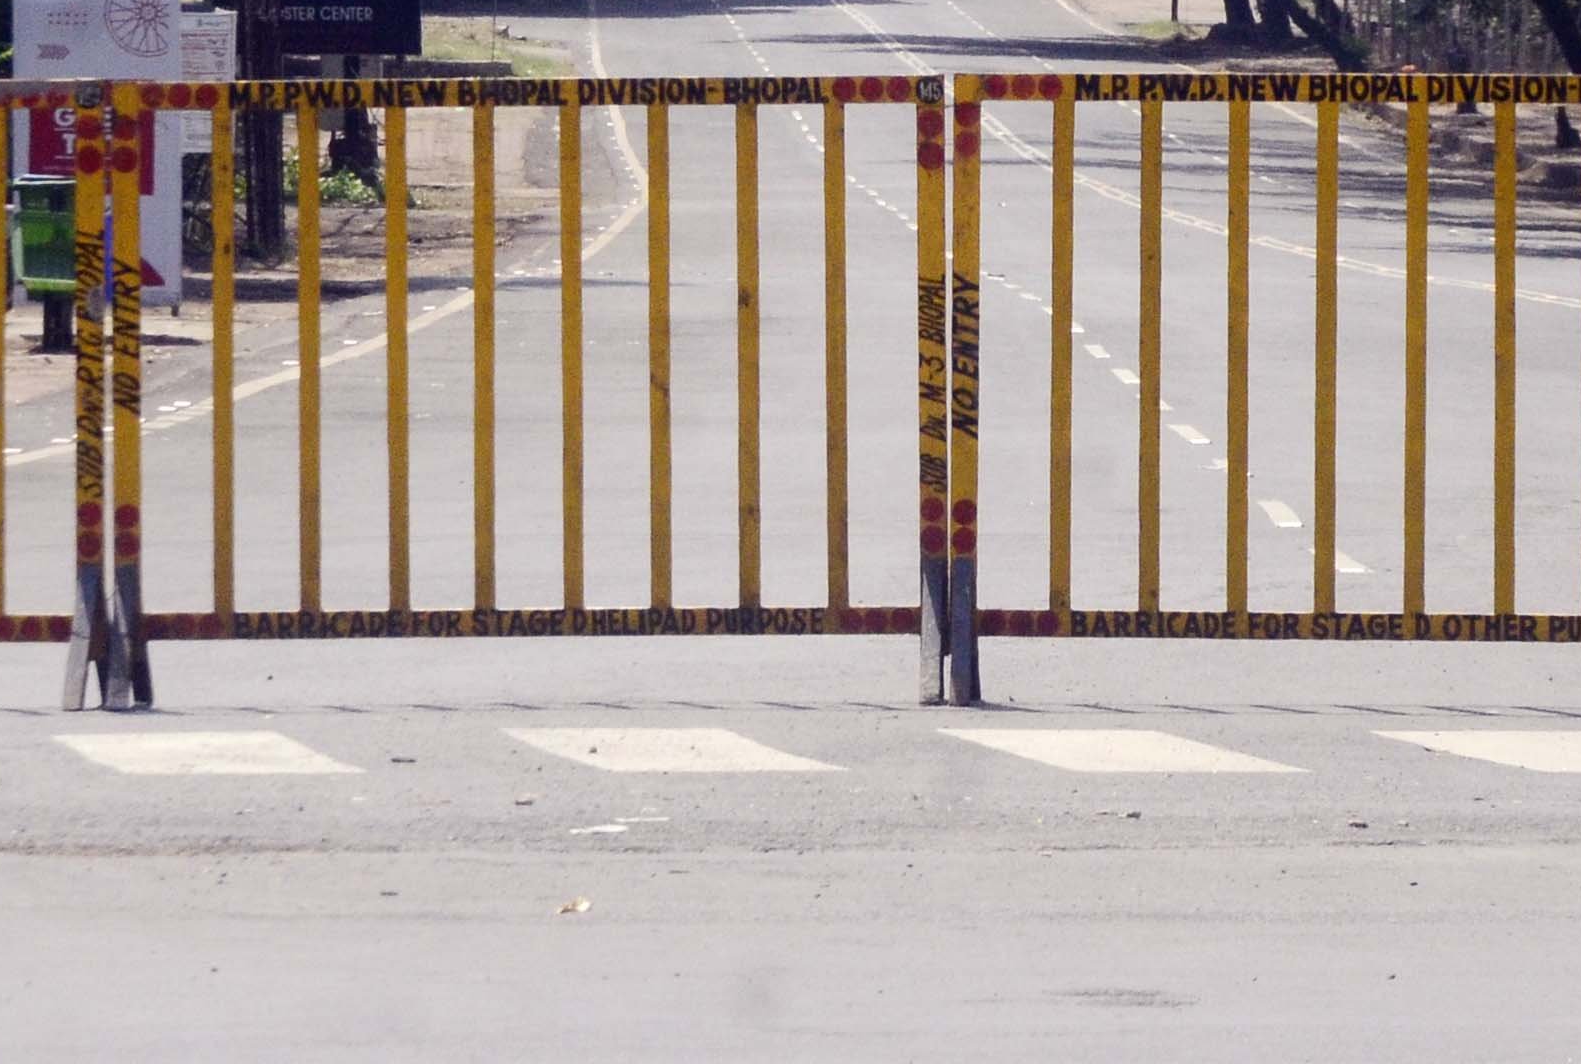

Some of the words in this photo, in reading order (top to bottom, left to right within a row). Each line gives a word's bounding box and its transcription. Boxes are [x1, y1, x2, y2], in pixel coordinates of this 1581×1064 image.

[320, 6, 374, 21] CENTER
[373, 81, 450, 108] NEW
[458, 80, 567, 106] BHOPAL
[1228, 76, 1301, 102] NEW
[1309, 76, 1418, 102] BHOPAL
[112, 257, 139, 359] ENTRY
[918, 273, 945, 345] BHOPAL
[951, 274, 978, 378] ENTRY
[112, 376, 139, 415] NO
[951, 389, 978, 441] NO
[76, 447, 105, 497] SUB
[918, 455, 946, 494] SUB
[233, 611, 406, 638] BARRICADE
[413, 610, 462, 636] FOR
[472, 609, 567, 636] STAGE
[706, 609, 825, 635] PURPOSE
[1071, 612, 1237, 639] BARRICADE
[1247, 613, 1300, 640] FOR
[1311, 613, 1404, 641] STAGE
[1443, 614, 1538, 642] OTHER
